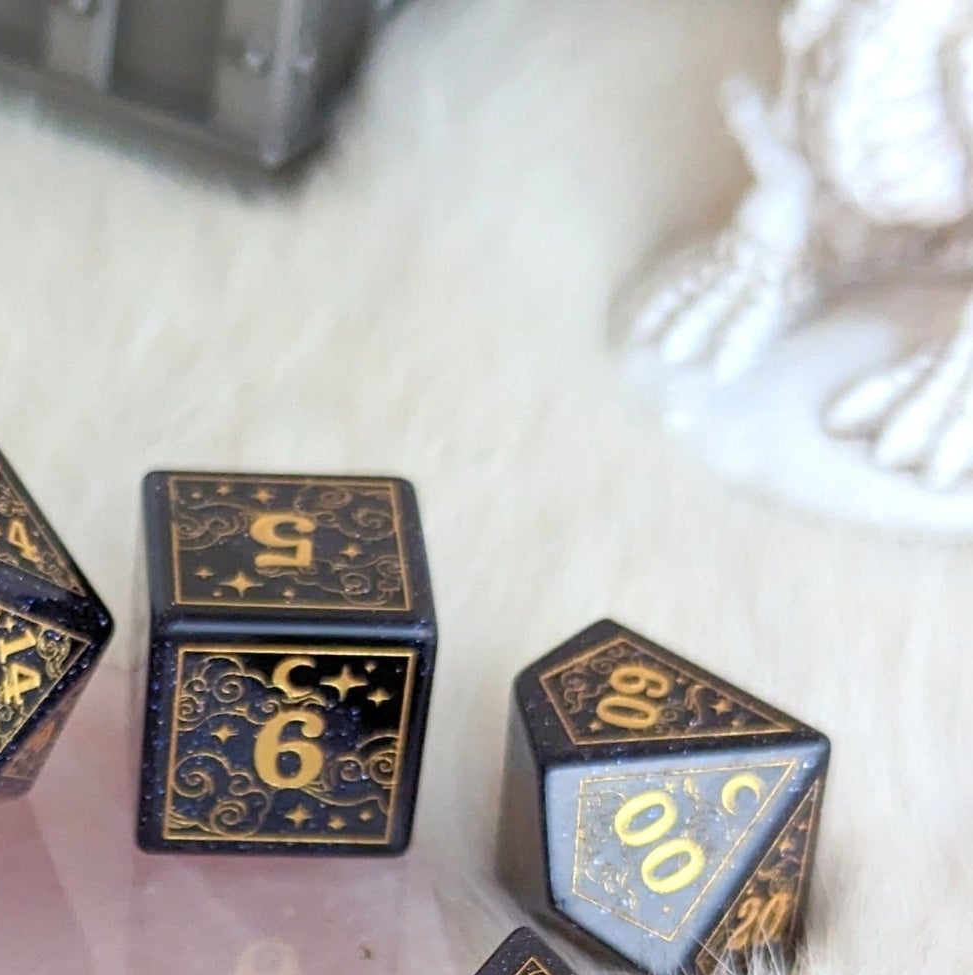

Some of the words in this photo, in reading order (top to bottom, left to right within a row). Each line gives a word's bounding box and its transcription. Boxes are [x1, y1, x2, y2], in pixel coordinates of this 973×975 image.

[6, 519, 42, 564] 4
[250, 512, 317, 568] 5
[254, 709, 325, 789] 6
[614, 790, 707, 894] 00
[728, 890, 792, 950] 20
